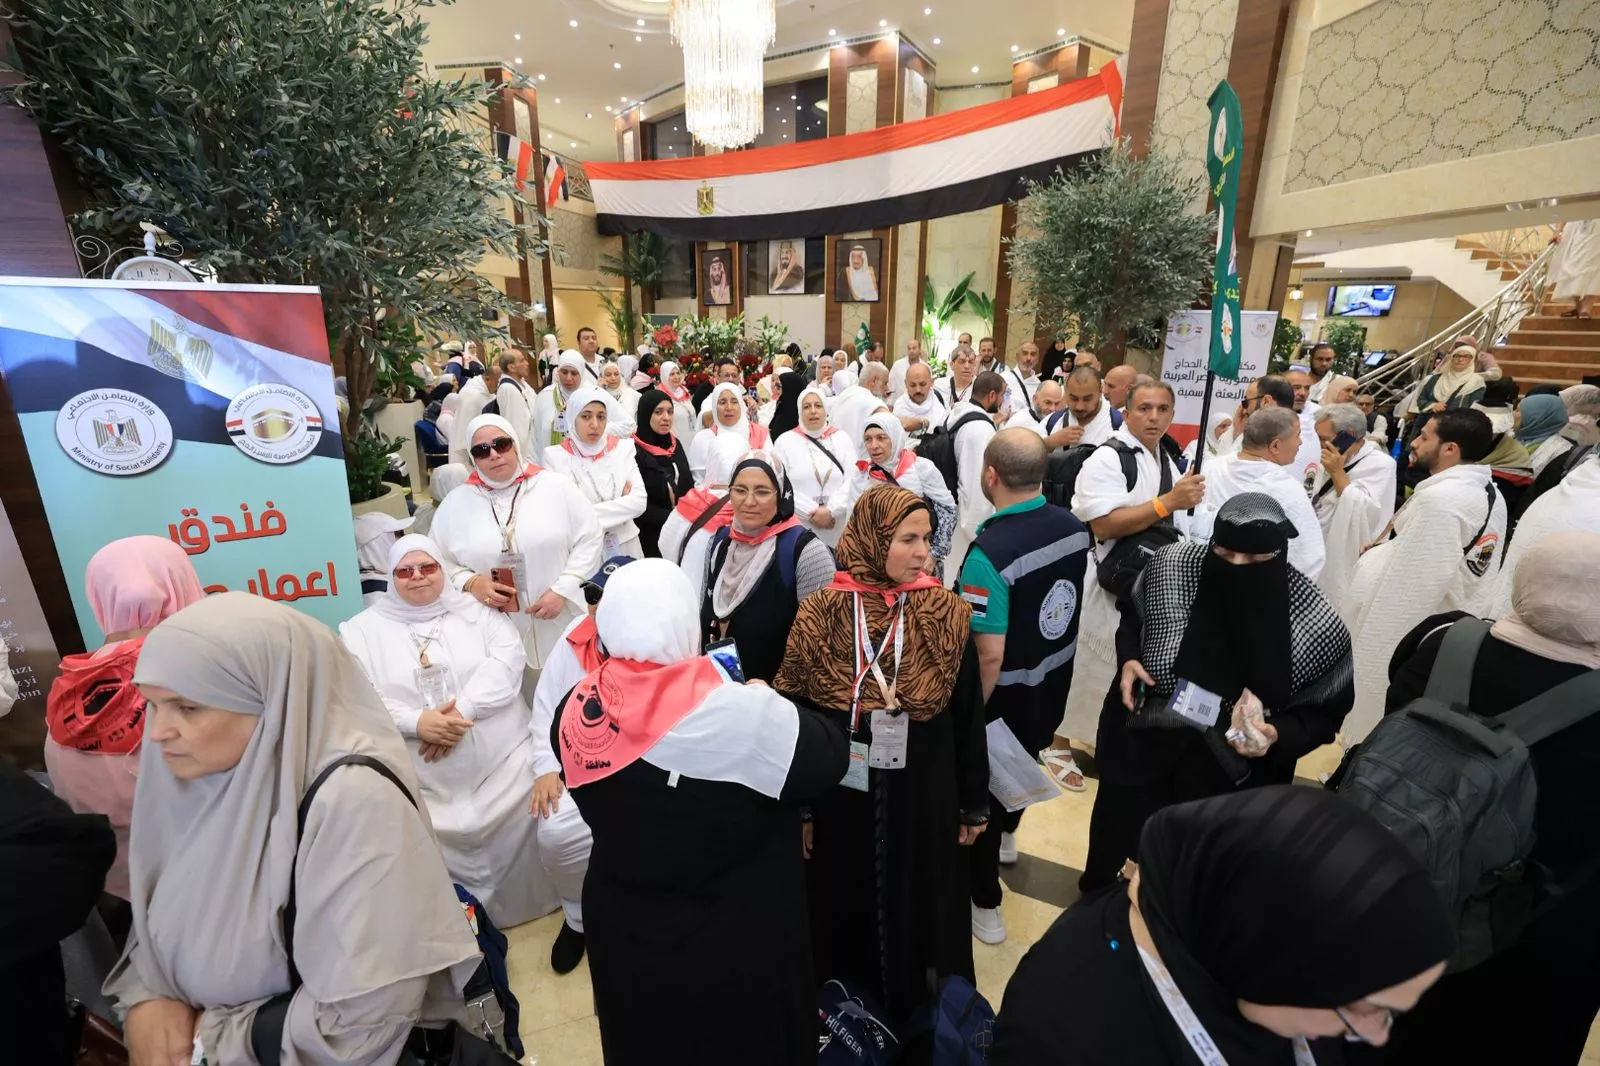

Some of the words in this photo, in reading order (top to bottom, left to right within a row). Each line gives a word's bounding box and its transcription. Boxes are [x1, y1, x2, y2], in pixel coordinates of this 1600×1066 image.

[1175, 358, 1202, 370] الحجاج
[1163, 370, 1195, 383] العربية
[67, 392, 100, 421] الاجتماعي
[101, 392, 138, 404] التضامن
[137, 400, 155, 417] وزارة
[70, 446, 103, 469] Ministry
[104, 463, 114, 471] of
[115, 462, 141, 471] Social
[140, 441, 167, 467] Solidarity
[168, 501, 287, 555] فندق
[825, 1015, 863, 1057] HILFIGER
